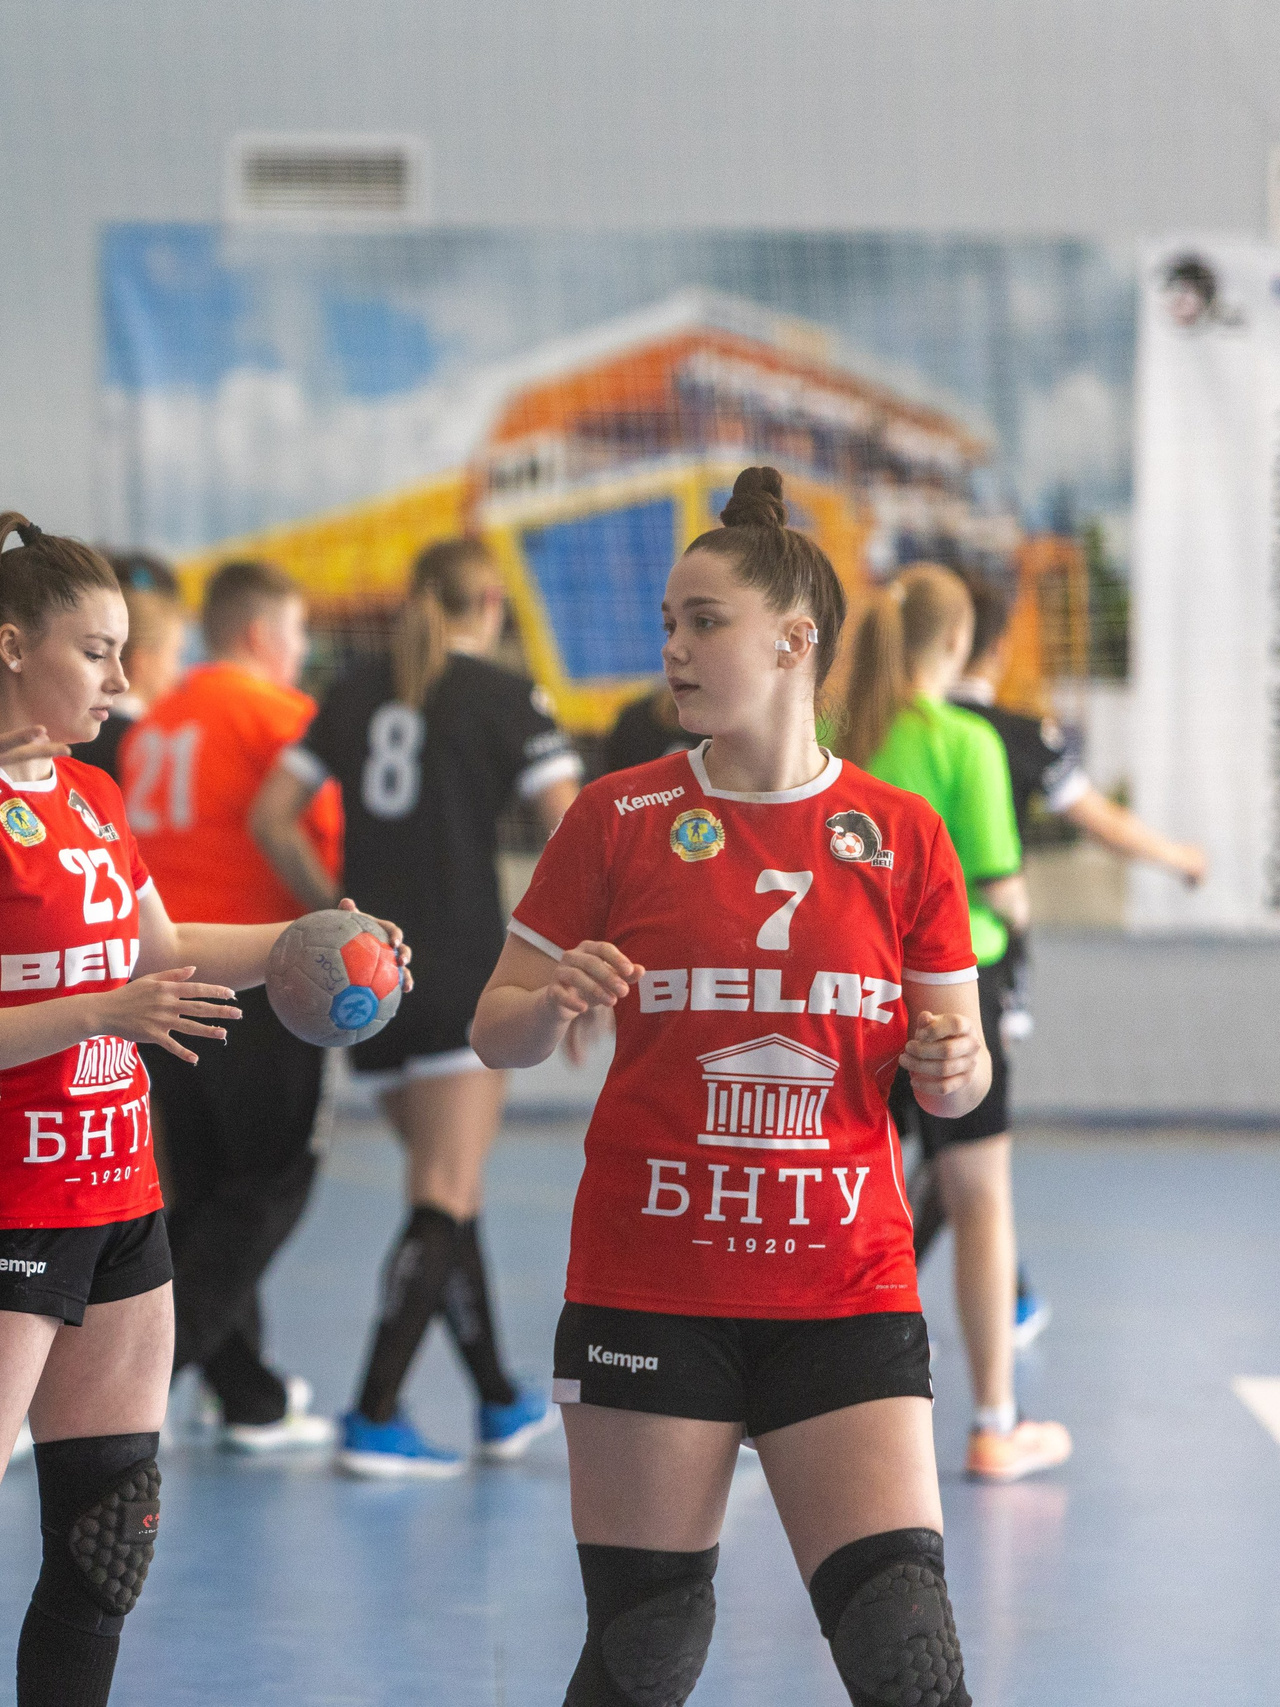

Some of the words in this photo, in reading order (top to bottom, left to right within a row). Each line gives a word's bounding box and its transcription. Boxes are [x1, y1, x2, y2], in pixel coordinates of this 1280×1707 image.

[124, 722, 201, 832] 21
[362, 702, 422, 818] 8
[614, 786, 685, 815] Kempa
[58, 847, 133, 924] 23
[755, 869, 814, 950] 7
[0, 938, 140, 991] BEL
[639, 967, 902, 1024] BELAZ
[641, 1158, 870, 1225] БНТУ
[588, 1344, 658, 1373] Kempa
